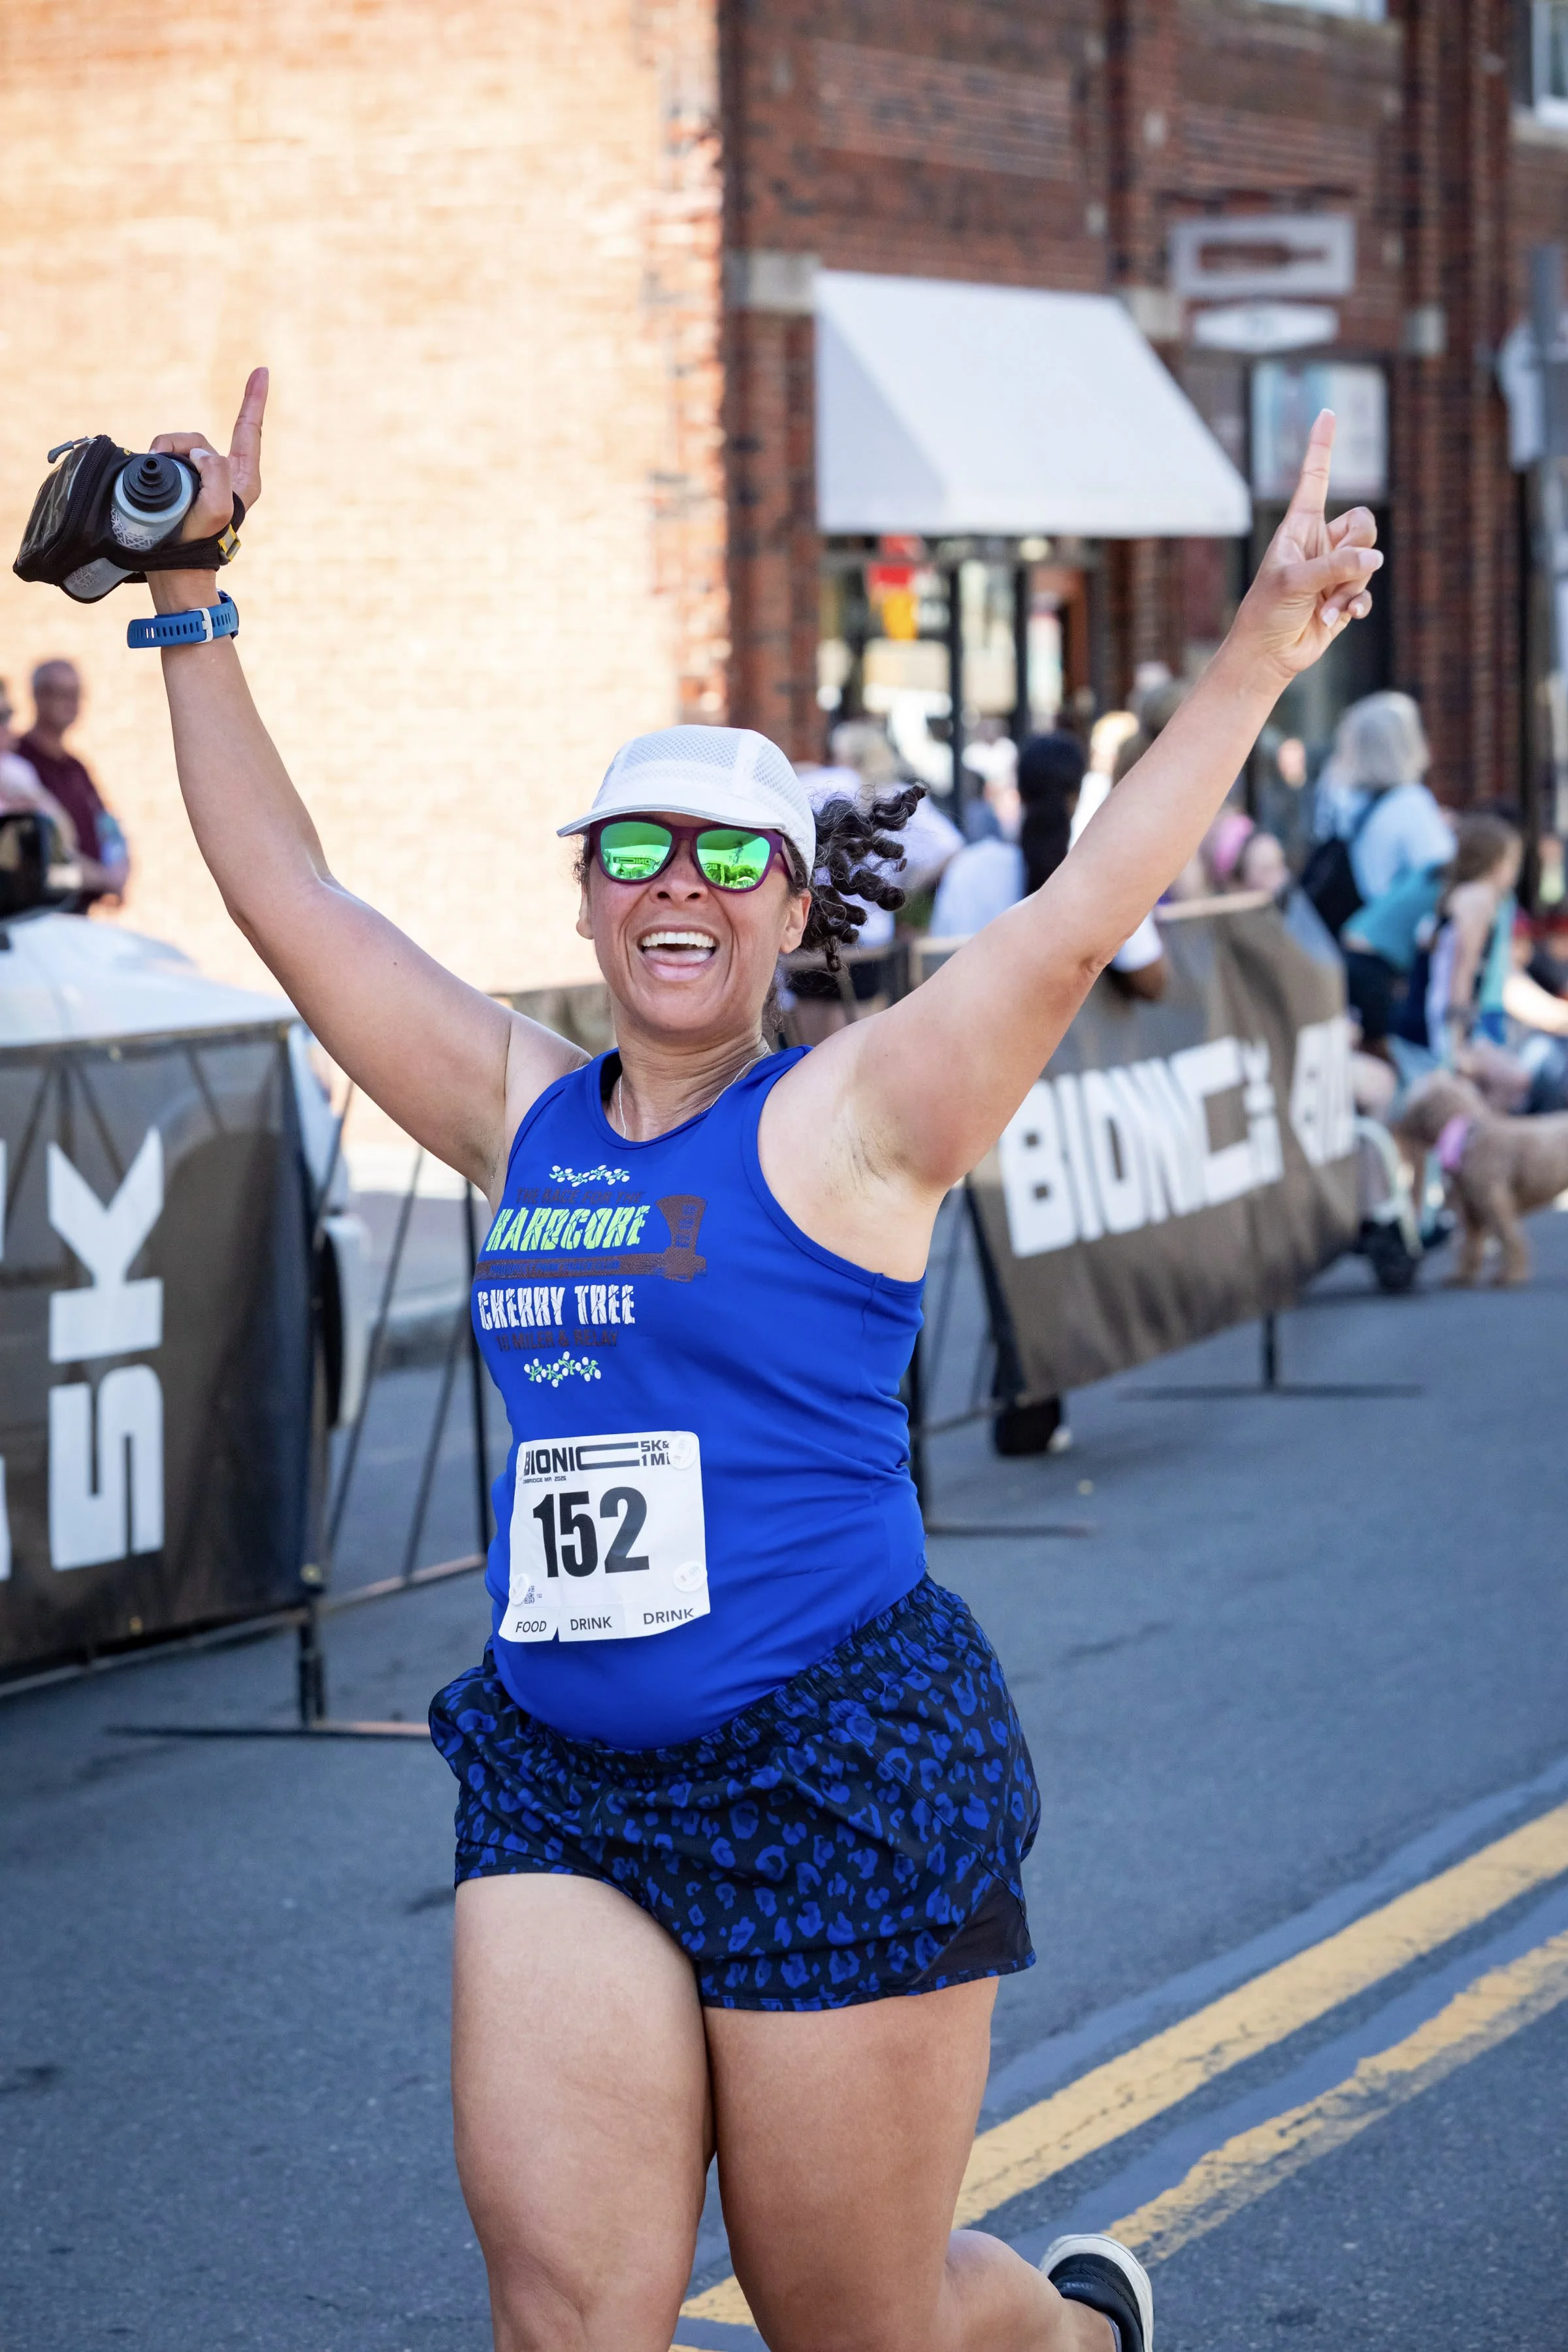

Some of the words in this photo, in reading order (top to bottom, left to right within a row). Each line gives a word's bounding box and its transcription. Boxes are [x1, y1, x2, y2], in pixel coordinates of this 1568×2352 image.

[516, 1187, 540, 1204] THE
[542, 1188, 580, 1204] RACE
[581, 1190, 612, 1205] FOR
[615, 1191, 646, 1205] THE
[485, 1205, 651, 1252] HARDCORE
[478, 1286, 566, 1330] CHERRY
[574, 1284, 636, 1325] TREE
[48, 1125, 165, 1572] 5K
[496, 1333, 510, 1352] 10
[512, 1330, 555, 1350] MILER
[558, 1330, 570, 1347] &
[573, 1328, 618, 1347] RELAY
[524, 1441, 641, 1477] BIONIC
[532, 1486, 650, 1578] 152
[515, 1620, 547, 1633] FOOD
[570, 1616, 612, 1631] DRINK
[643, 1608, 694, 1625] DRINK
